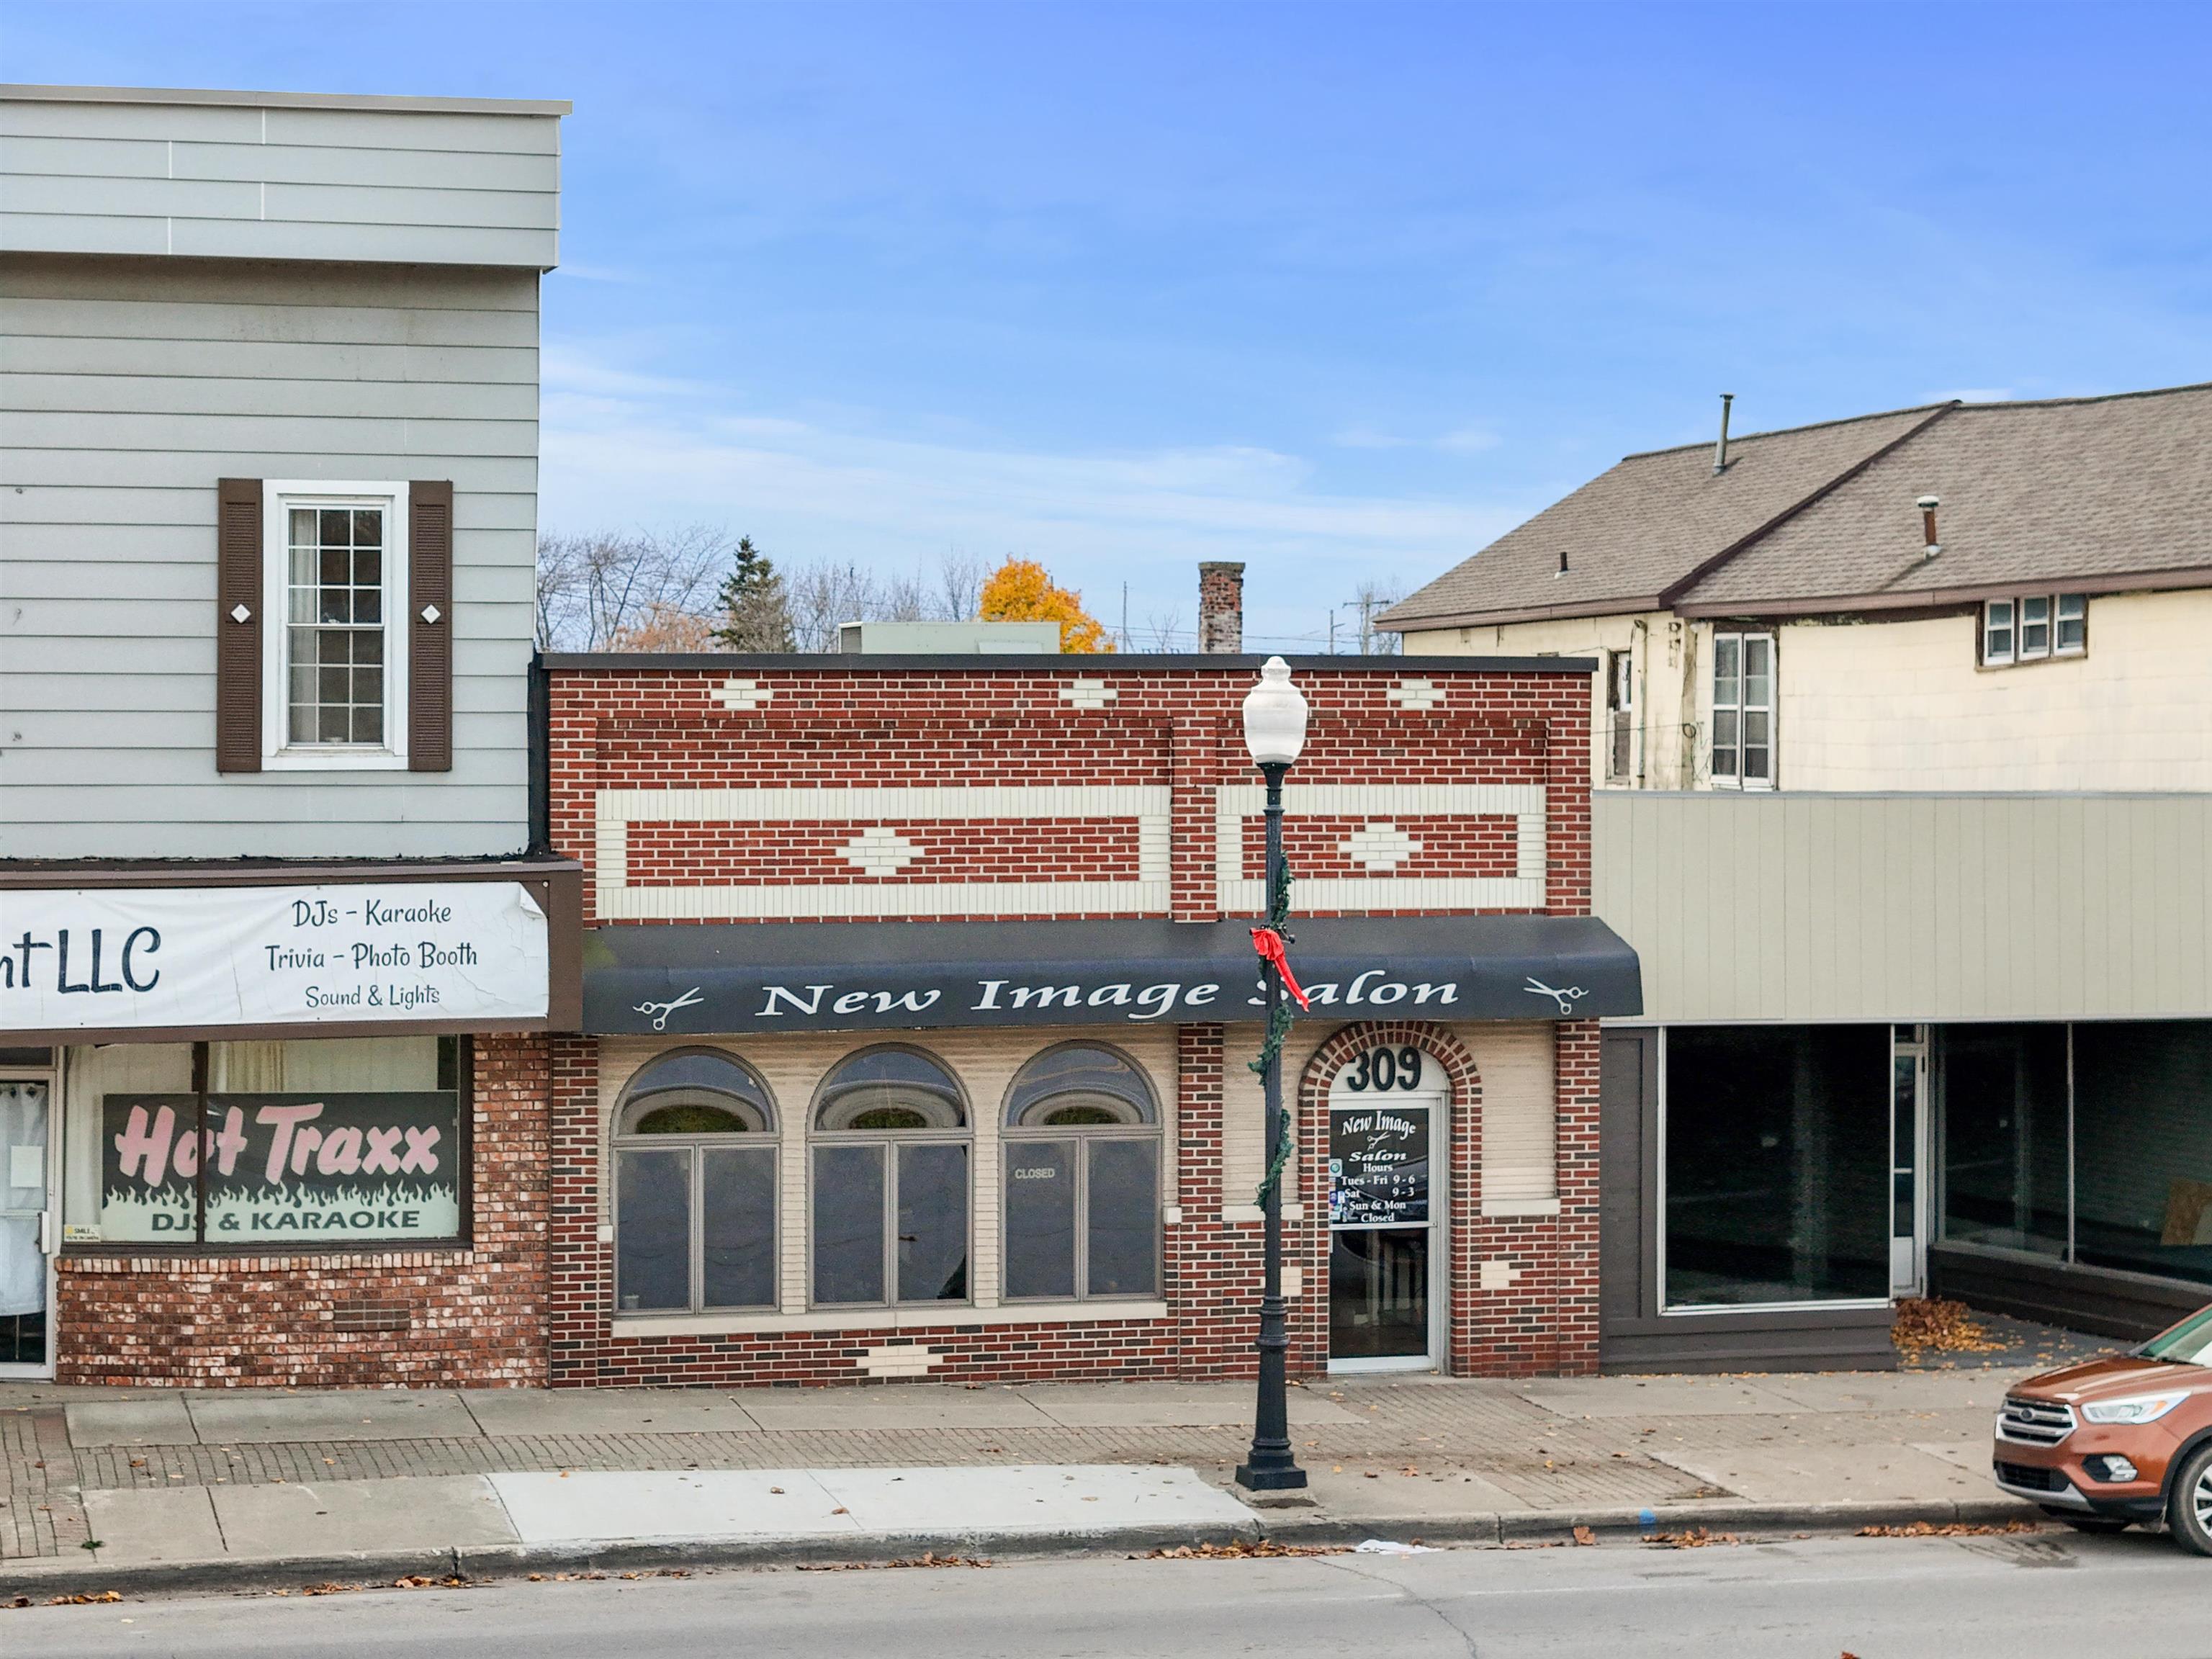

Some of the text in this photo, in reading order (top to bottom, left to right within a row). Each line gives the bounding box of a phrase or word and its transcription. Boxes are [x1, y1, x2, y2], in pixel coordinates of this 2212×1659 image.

[292, 899, 338, 927] DJs
[365, 899, 452, 926] Karaoke
[58, 926, 161, 994] LLC
[264, 945, 325, 971] Trivia
[351, 942, 411, 970] Photo
[417, 940, 478, 969] Booth
[305, 984, 441, 1010] Sound & Lights
[755, 984, 941, 1017] New
[971, 979, 1220, 1020] Image
[1346, 1046, 1422, 1092] 309
[1341, 1110, 1417, 1141] New Image
[114, 1102, 442, 1188] Hot Traxx
[1349, 1148, 1407, 1162] Salon
[1015, 1168, 1056, 1179] CLOSED
[1362, 1162, 1393, 1172] Hours
[1341, 1175, 1365, 1186] Tues
[1372, 1174, 1388, 1185] Fri
[1393, 1174, 1401, 1184] 9
[1408, 1174, 1416, 1184] 6
[1344, 1188, 1361, 1199] Sat
[1392, 1187, 1399, 1197] 9
[1408, 1187, 1415, 1197] 3
[1349, 1200, 1406, 1210] Sun & Mon
[218, 1213, 240, 1231] &
[251, 1210, 421, 1231] KARAOKE
[1360, 1212, 1395, 1223] Closed
